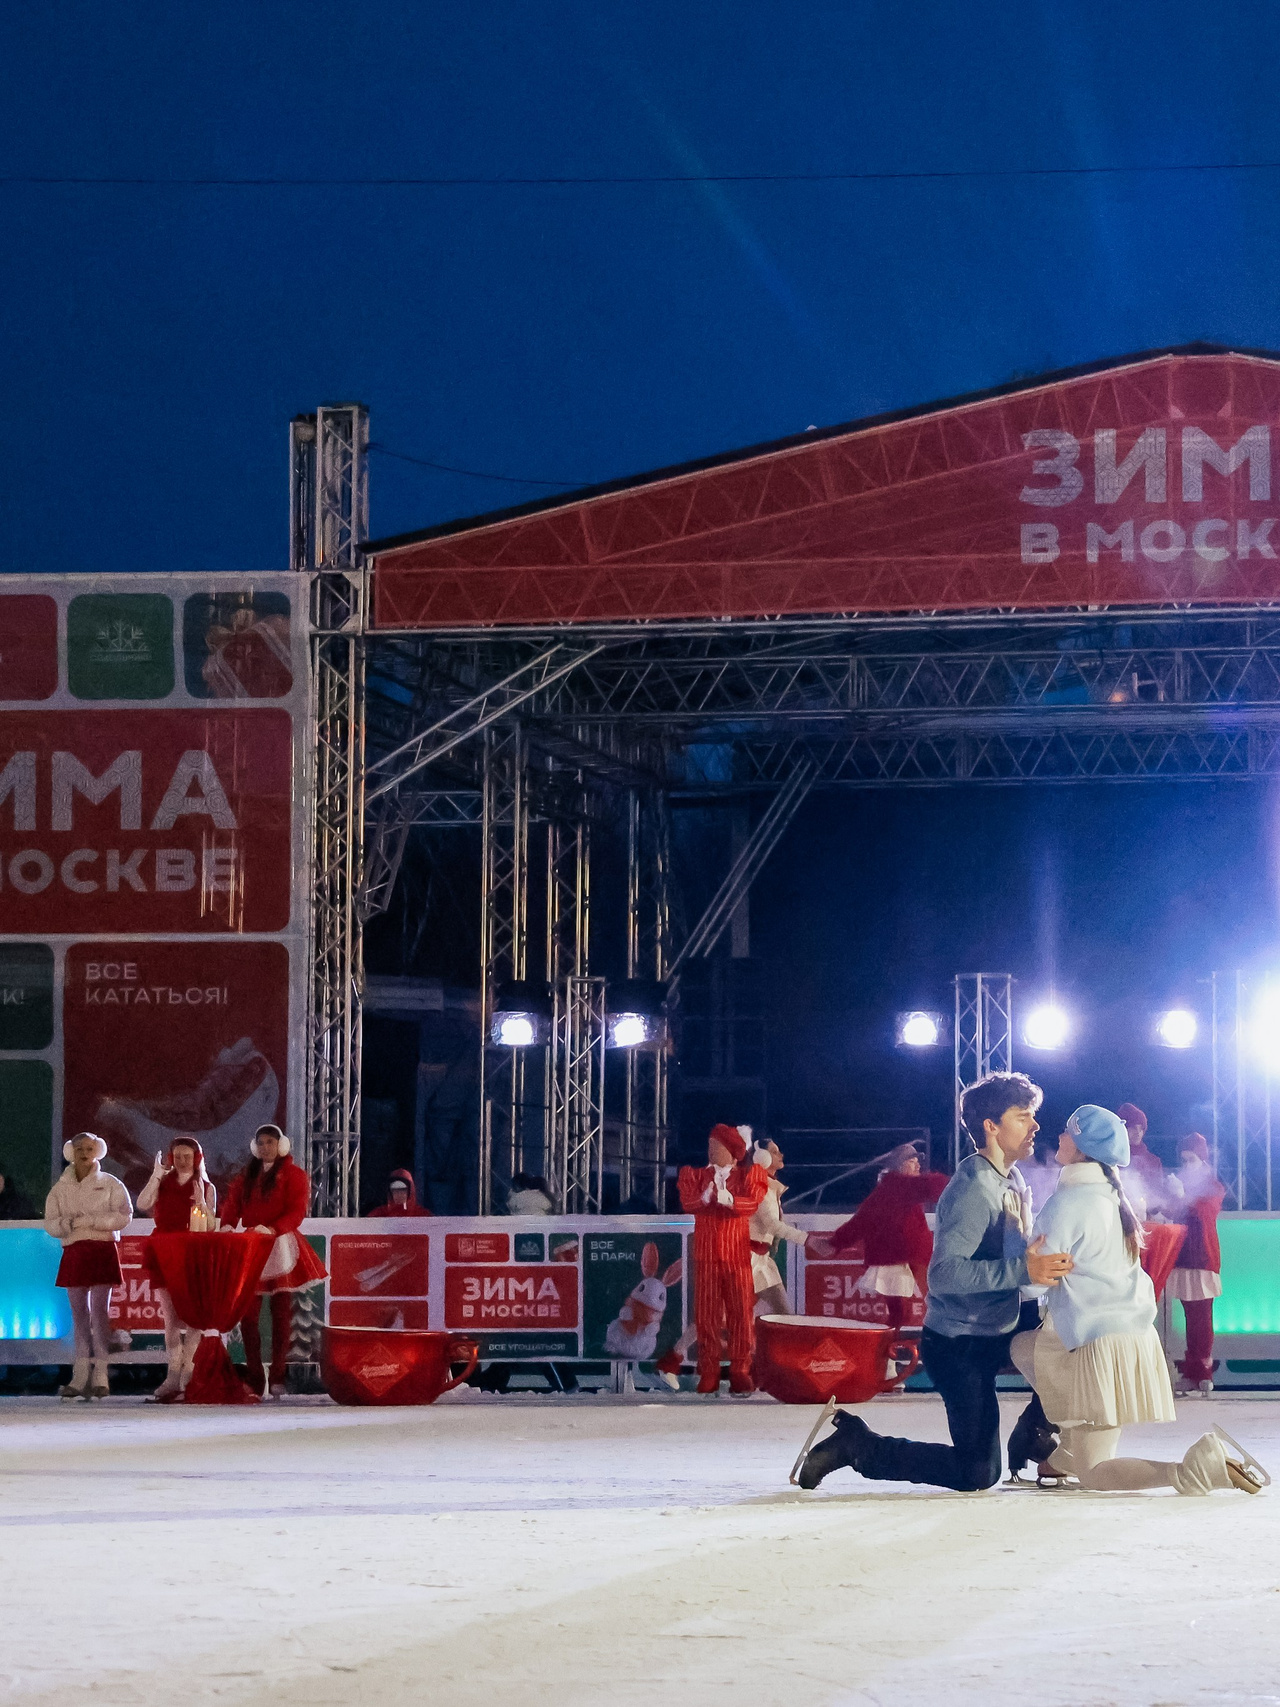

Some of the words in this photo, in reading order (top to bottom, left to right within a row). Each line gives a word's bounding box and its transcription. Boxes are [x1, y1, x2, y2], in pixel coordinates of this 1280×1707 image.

[1020, 523, 1060, 564] В
[0, 849, 239, 894] ОСКВЕ
[85, 962, 138, 980] ВСЕ
[85, 987, 228, 1005] КАТАТЬСЯ!
[590, 1240, 615, 1250] ВСЕ
[590, 1252, 599, 1261] В
[601, 1252, 636, 1261] ПАРК!
[462, 1277, 560, 1301] ЗИМА
[462, 1304, 475, 1318] В
[481, 1304, 561, 1318] МОСКВЕ
